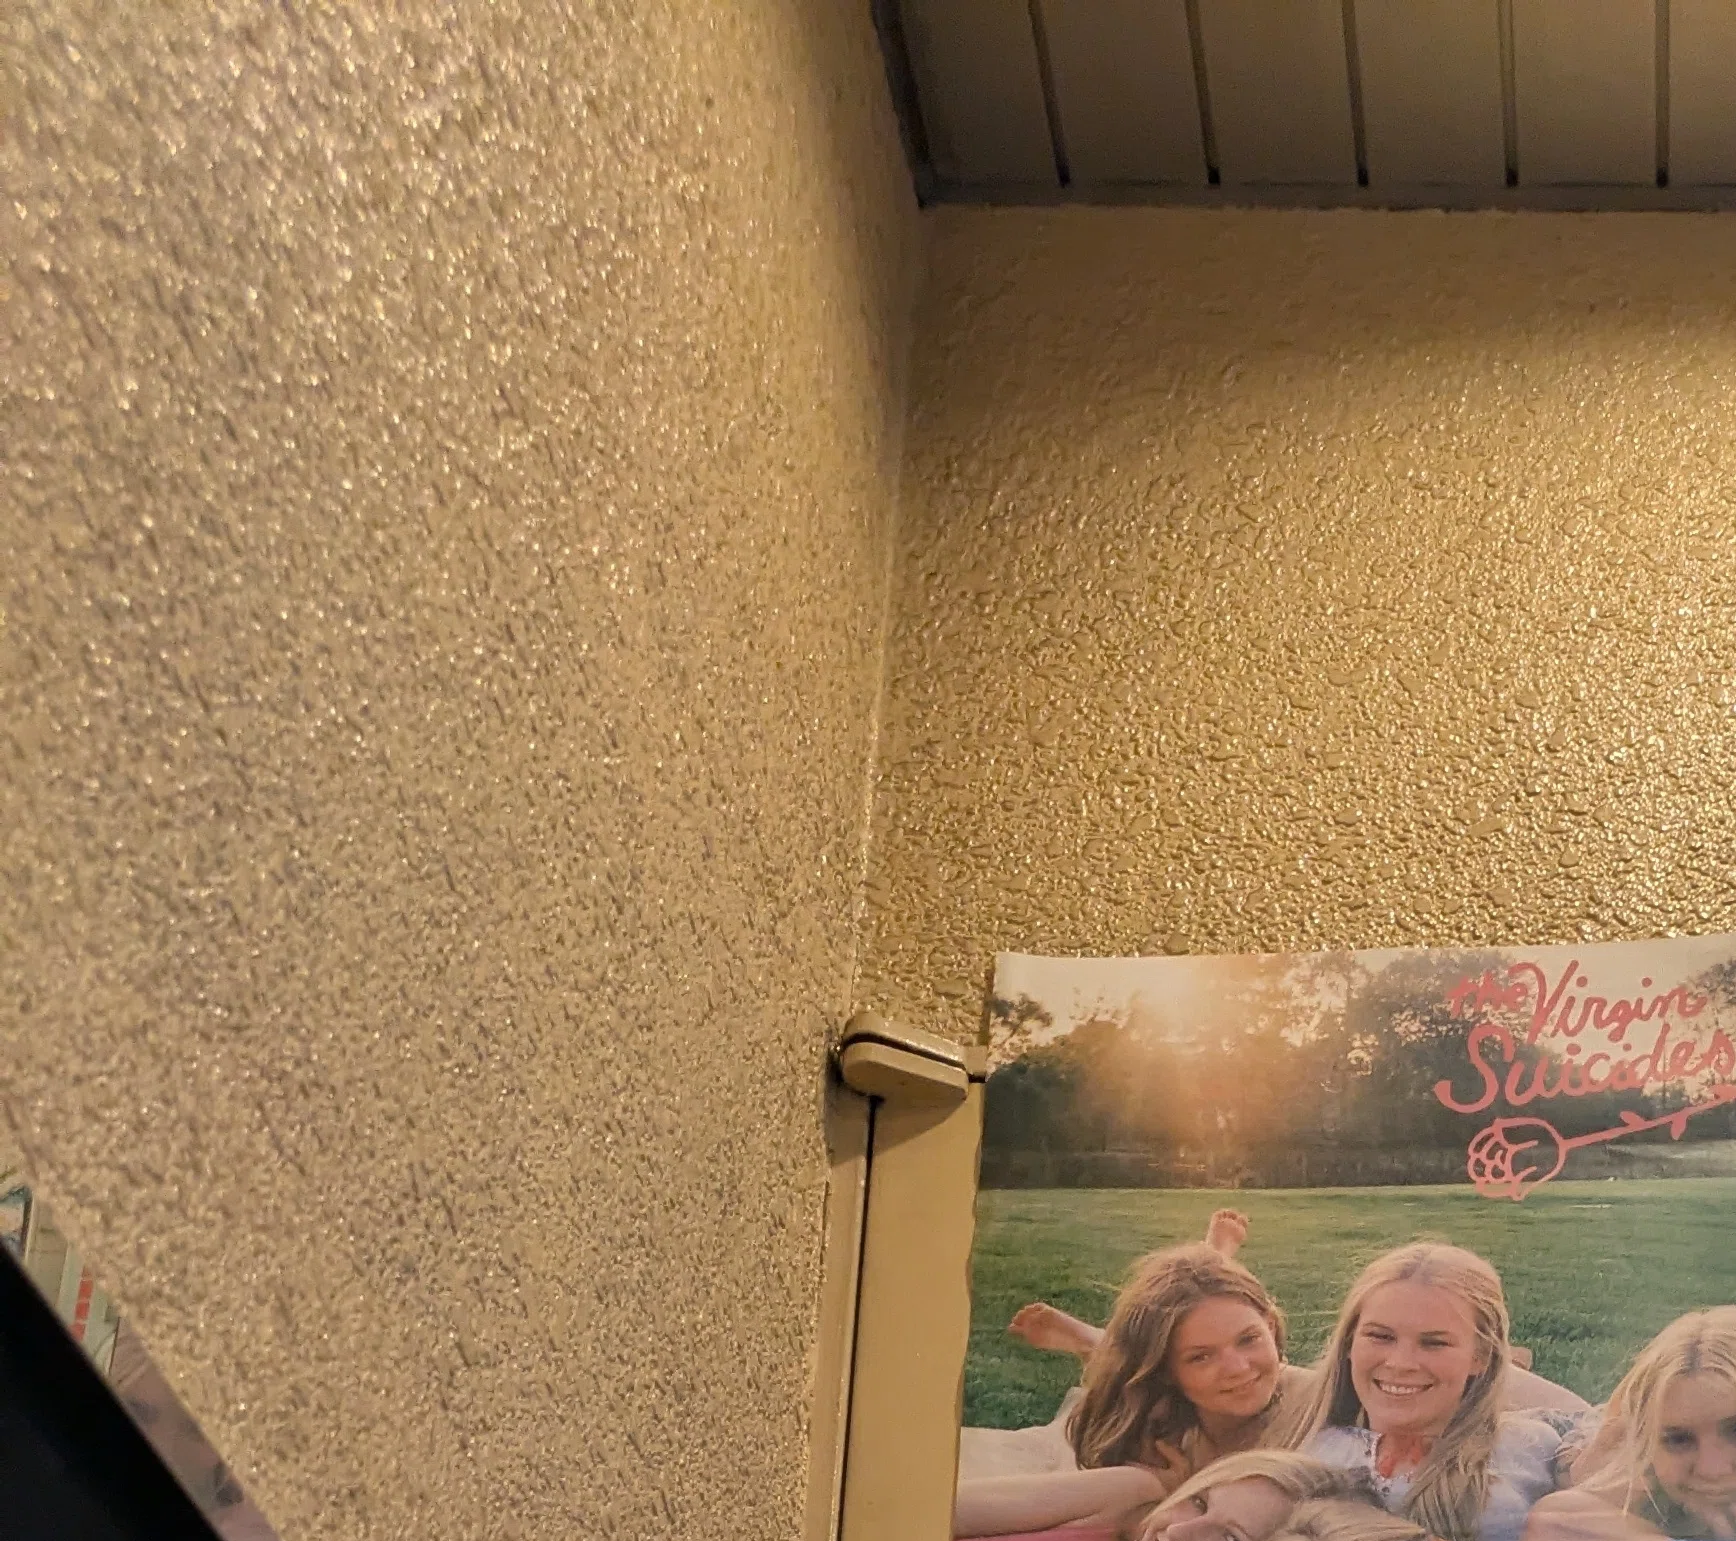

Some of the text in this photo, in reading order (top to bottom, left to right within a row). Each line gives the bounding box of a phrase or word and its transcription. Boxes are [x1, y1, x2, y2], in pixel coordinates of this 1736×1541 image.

[1447, 960, 1708, 1043] the Virgin
[1433, 1023, 1736, 1113] Suicides
